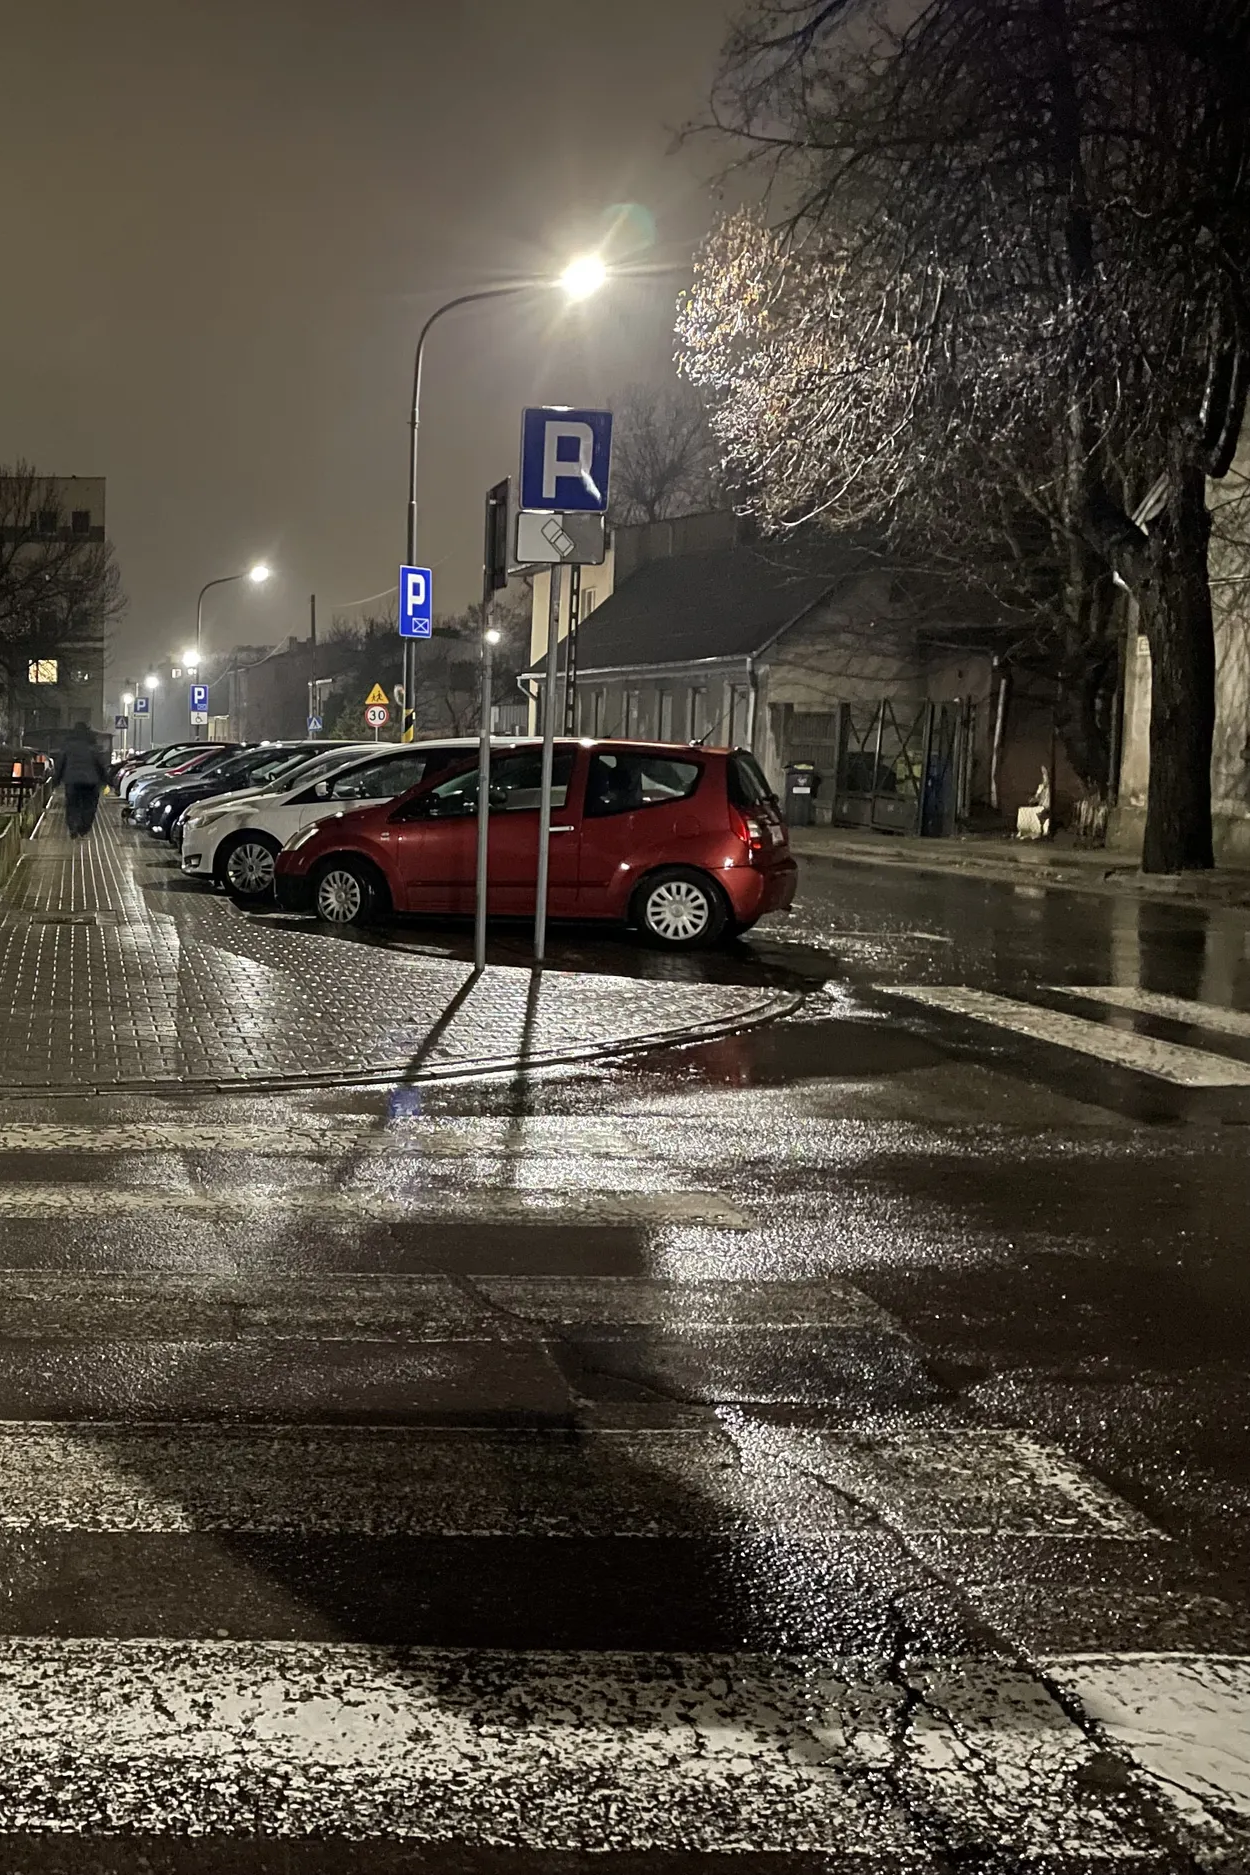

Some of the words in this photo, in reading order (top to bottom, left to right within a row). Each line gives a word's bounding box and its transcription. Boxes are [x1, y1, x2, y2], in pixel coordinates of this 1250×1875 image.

[542, 420, 595, 499] P
[406, 572, 426, 617] P
[136, 698, 147, 712] P
[193, 687, 205, 705] P
[369, 709, 386, 722] 30
